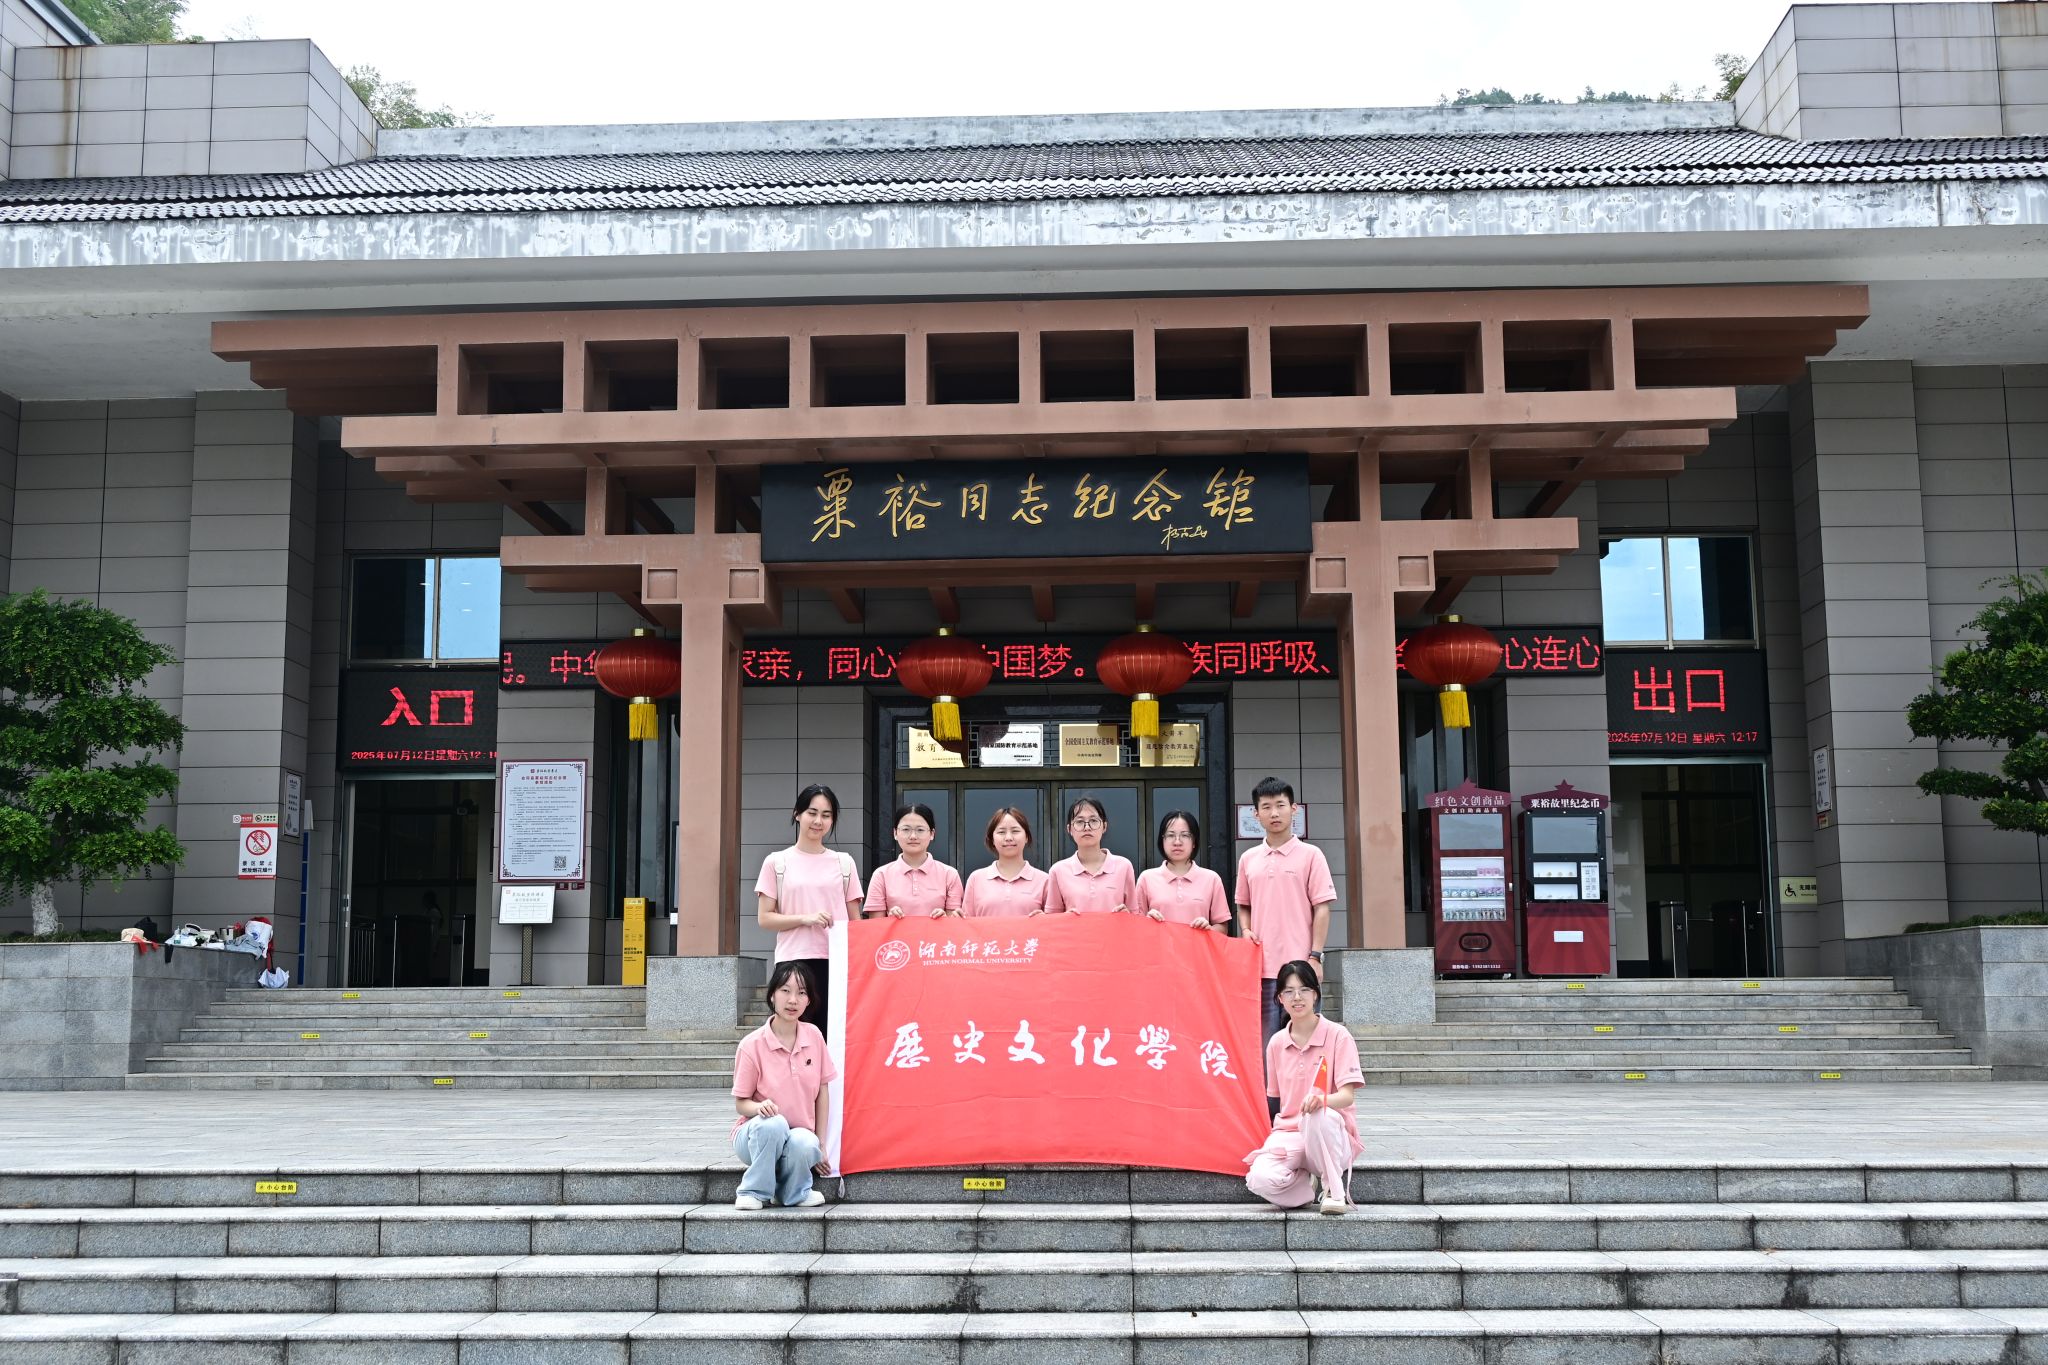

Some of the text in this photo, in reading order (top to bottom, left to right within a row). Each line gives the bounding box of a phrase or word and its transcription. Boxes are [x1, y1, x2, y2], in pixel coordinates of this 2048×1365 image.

[1633, 666, 1725, 713] 出口
[379, 686, 474, 726] 入口
[1434, 795, 1505, 808] 红色文创商品
[1531, 798, 1600, 809] 粟裕故里纪念币
